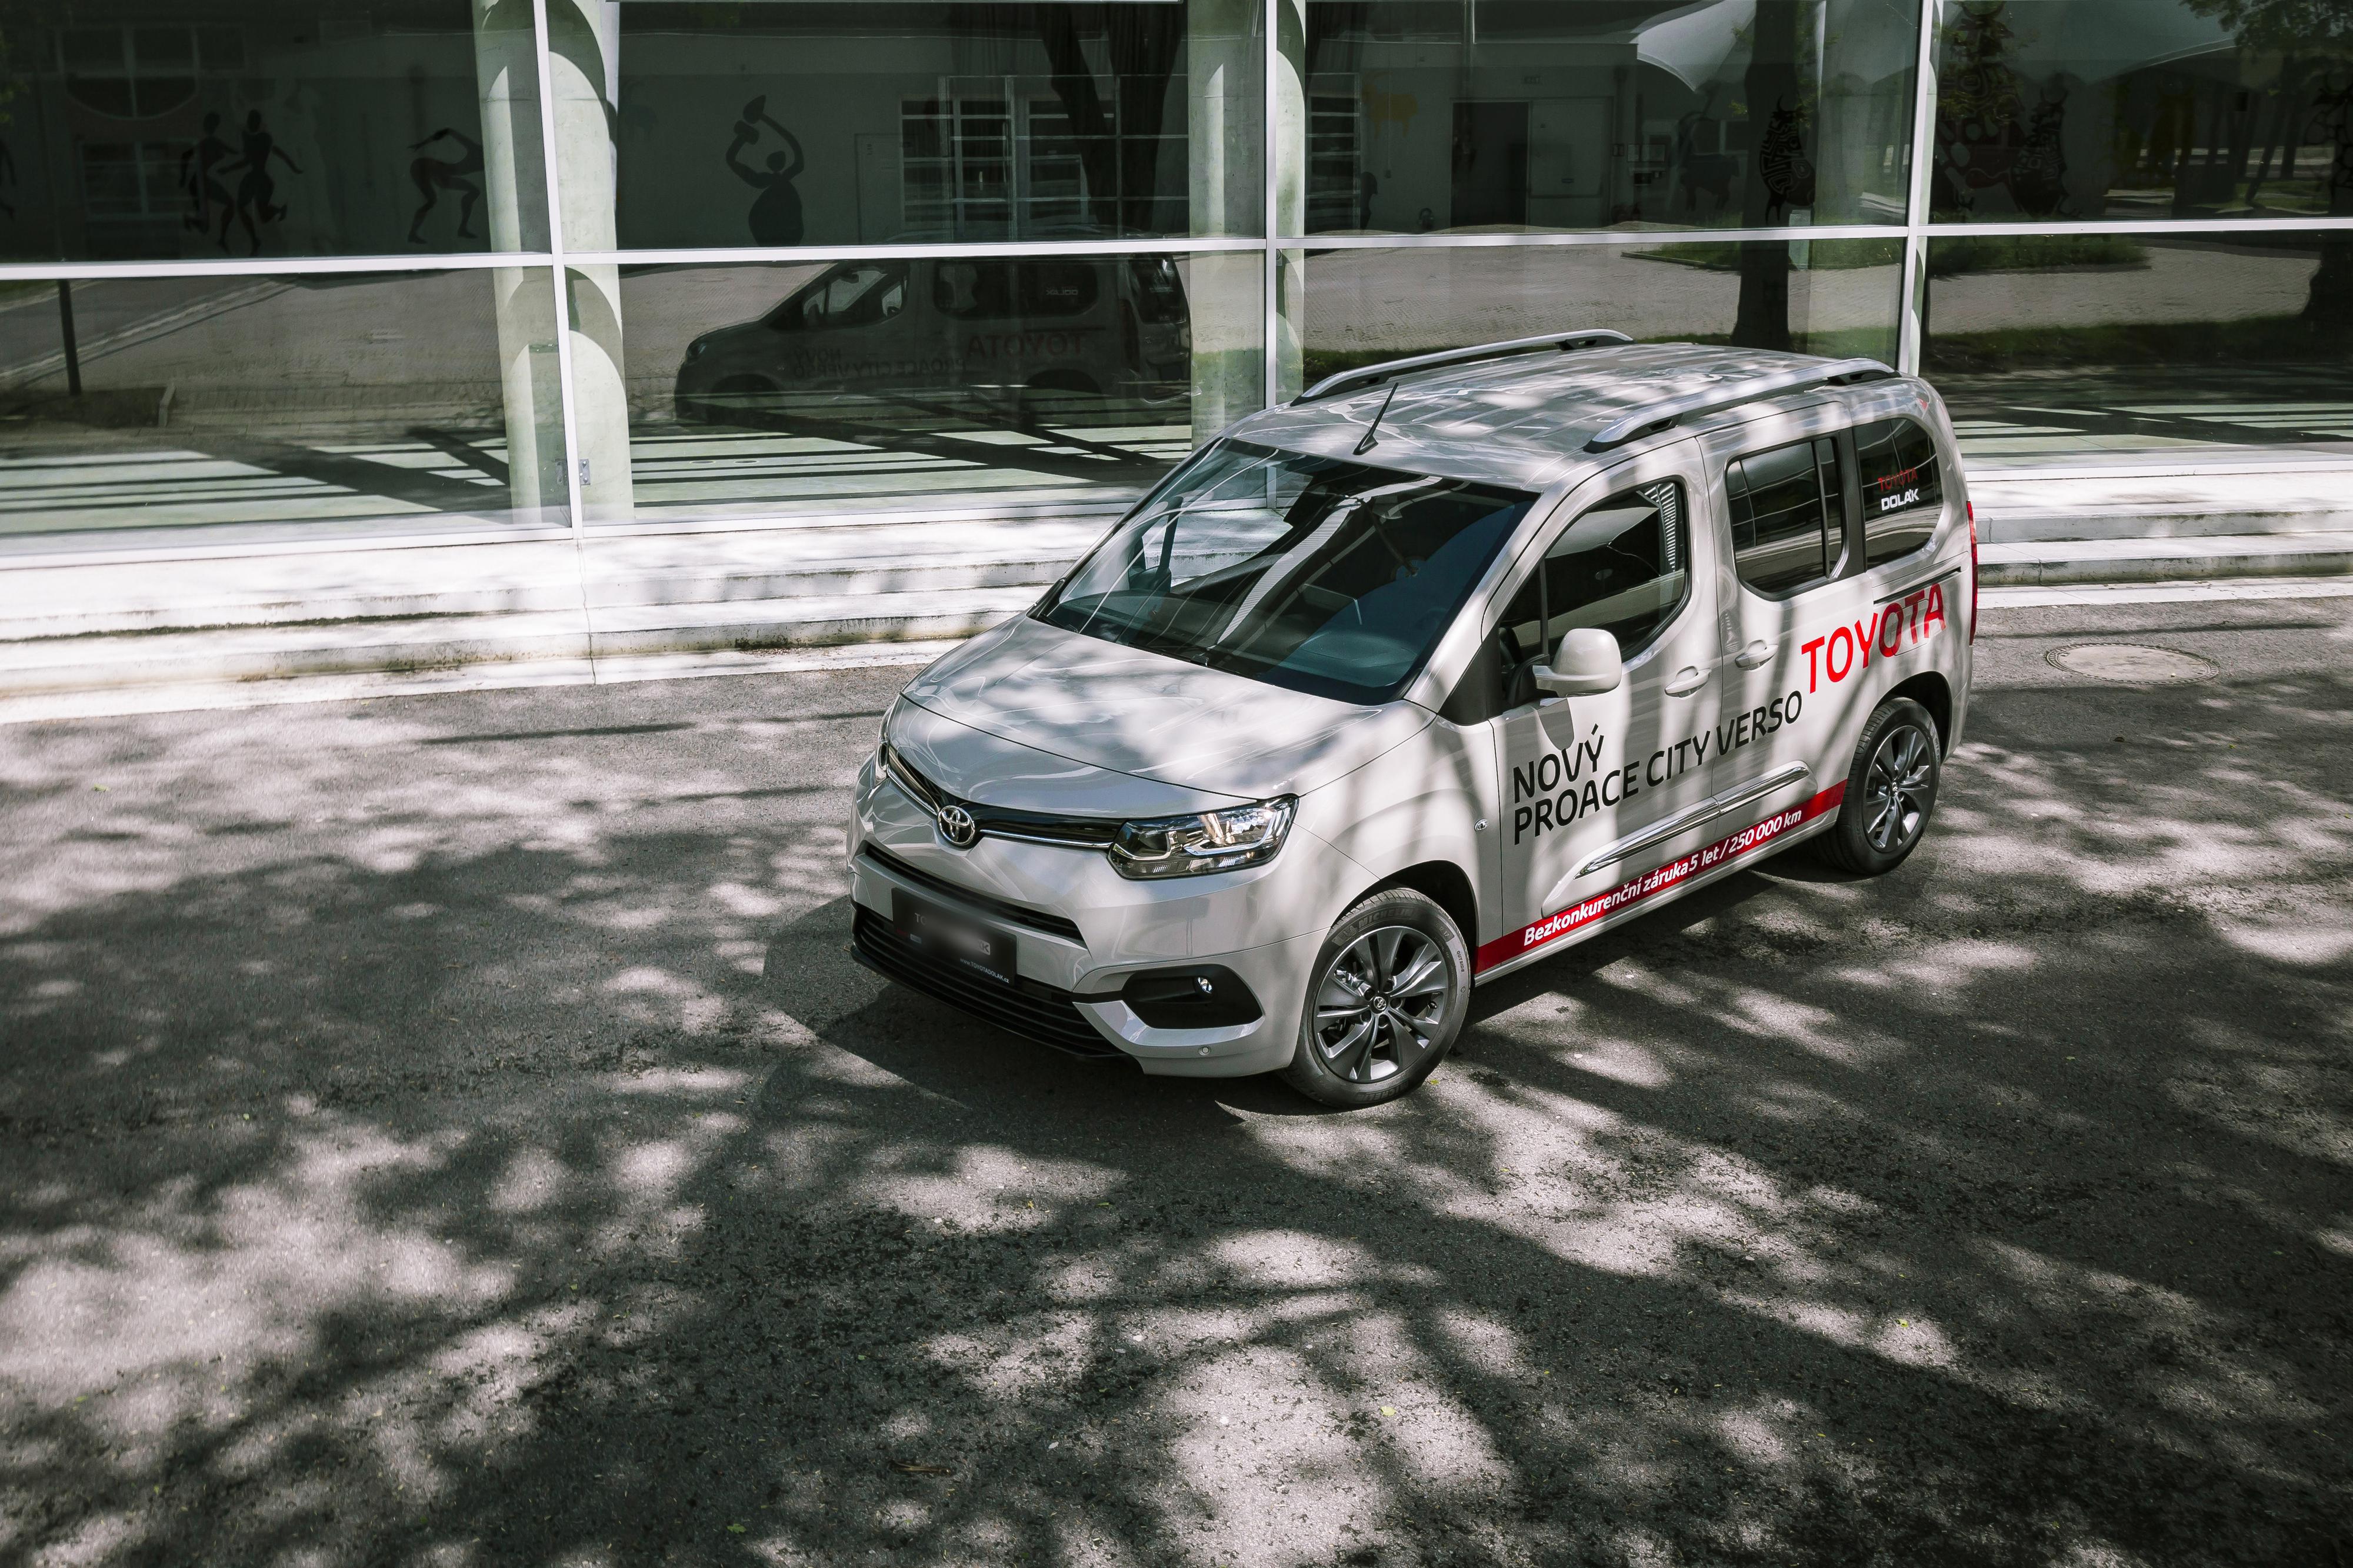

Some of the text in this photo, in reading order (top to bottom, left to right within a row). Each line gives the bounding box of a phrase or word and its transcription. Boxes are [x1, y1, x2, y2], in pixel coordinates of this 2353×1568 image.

[1878, 467, 1918, 491] TOYOTA
[1801, 583, 1947, 694] TOYOTA
[1513, 723, 1605, 804] NOVÝ
[1514, 690, 1802, 845] PROACE CITY VERSO
[1358, 907, 1414, 929] MICHELIN
[1524, 810, 1802, 946] Bezkonkurenční záruka 5 let / 250 000 km
[1457, 950, 1465, 973] OUTSIDE
